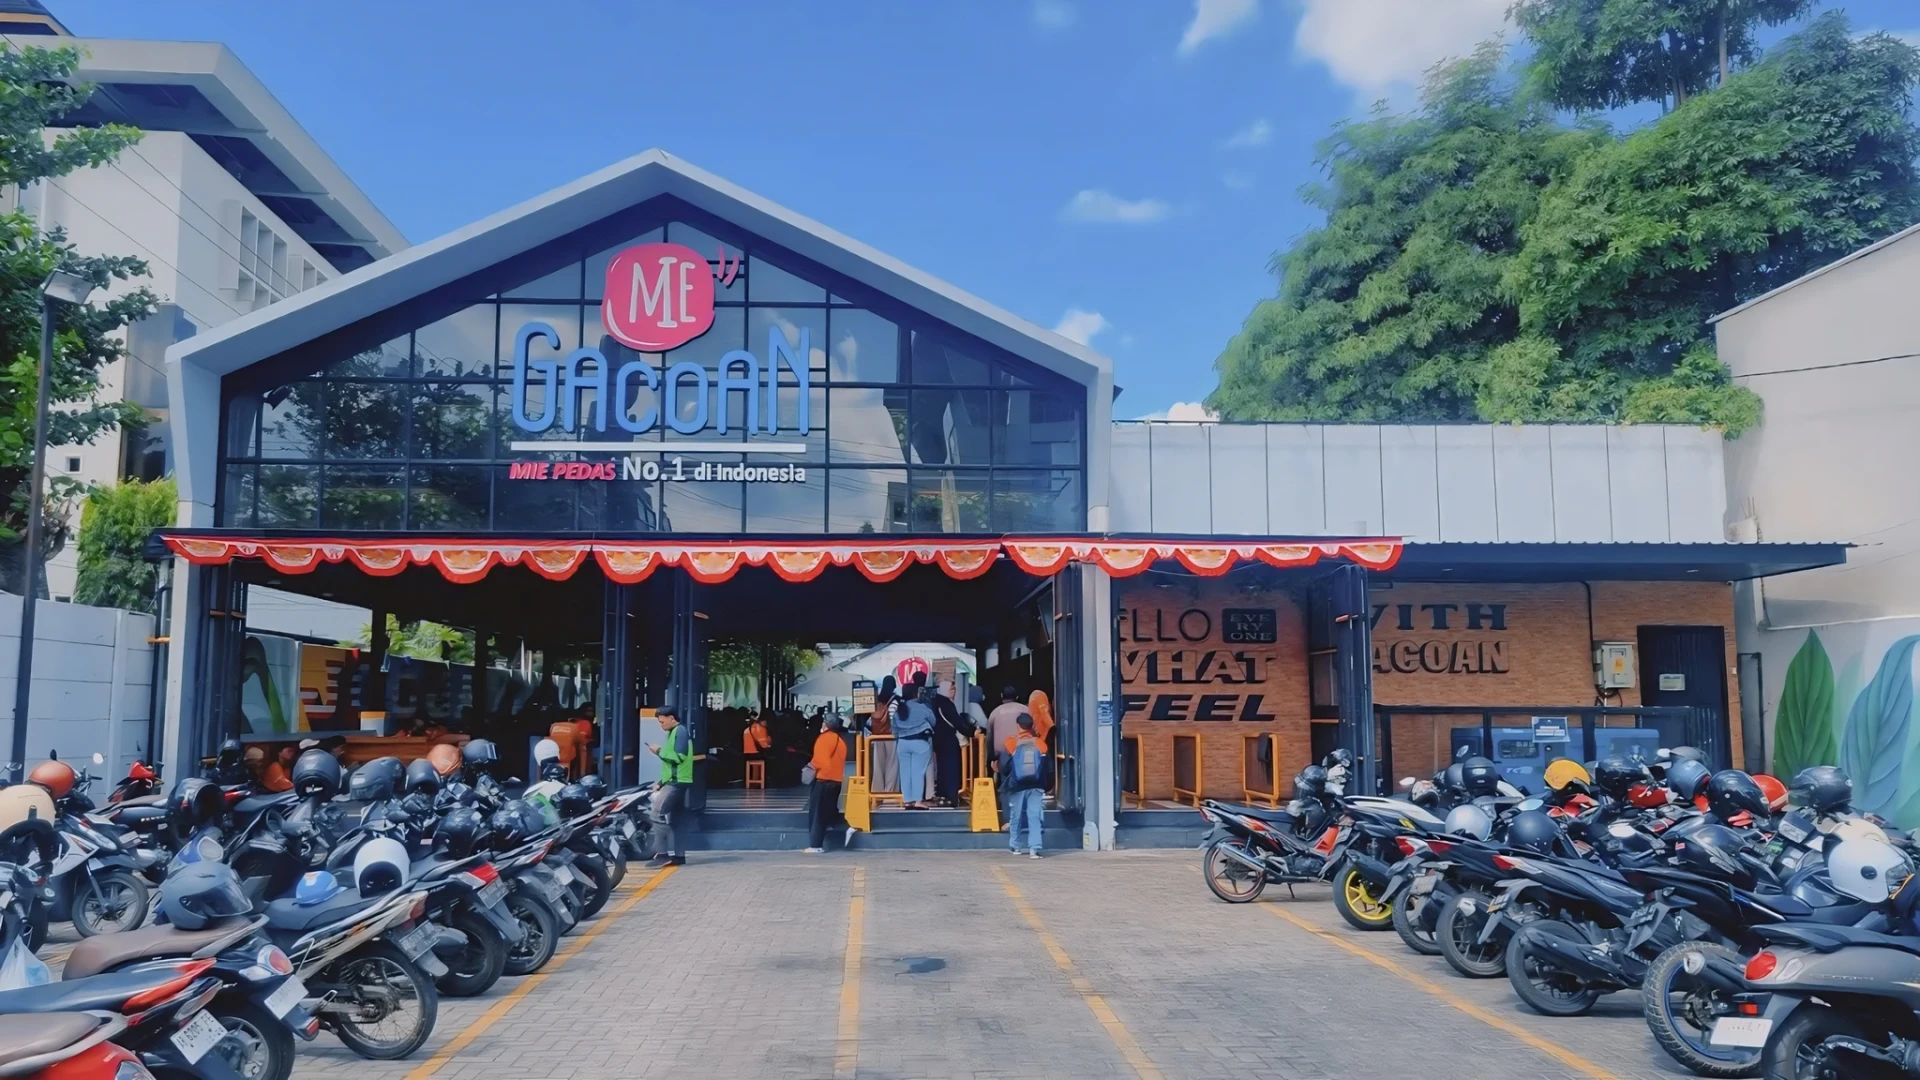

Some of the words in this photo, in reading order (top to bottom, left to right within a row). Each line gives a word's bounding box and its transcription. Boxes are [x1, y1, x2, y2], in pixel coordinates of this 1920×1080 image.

[628, 256, 696, 328] MIE
[511, 321, 810, 436] GACOAN
[509, 462, 549, 480] MIE
[552, 462, 616, 480] PEDAS
[622, 456, 686, 481] No.1
[694, 462, 712, 482] di
[716, 462, 806, 482] Indonesia
[1231, 633, 1271, 641] ONE
